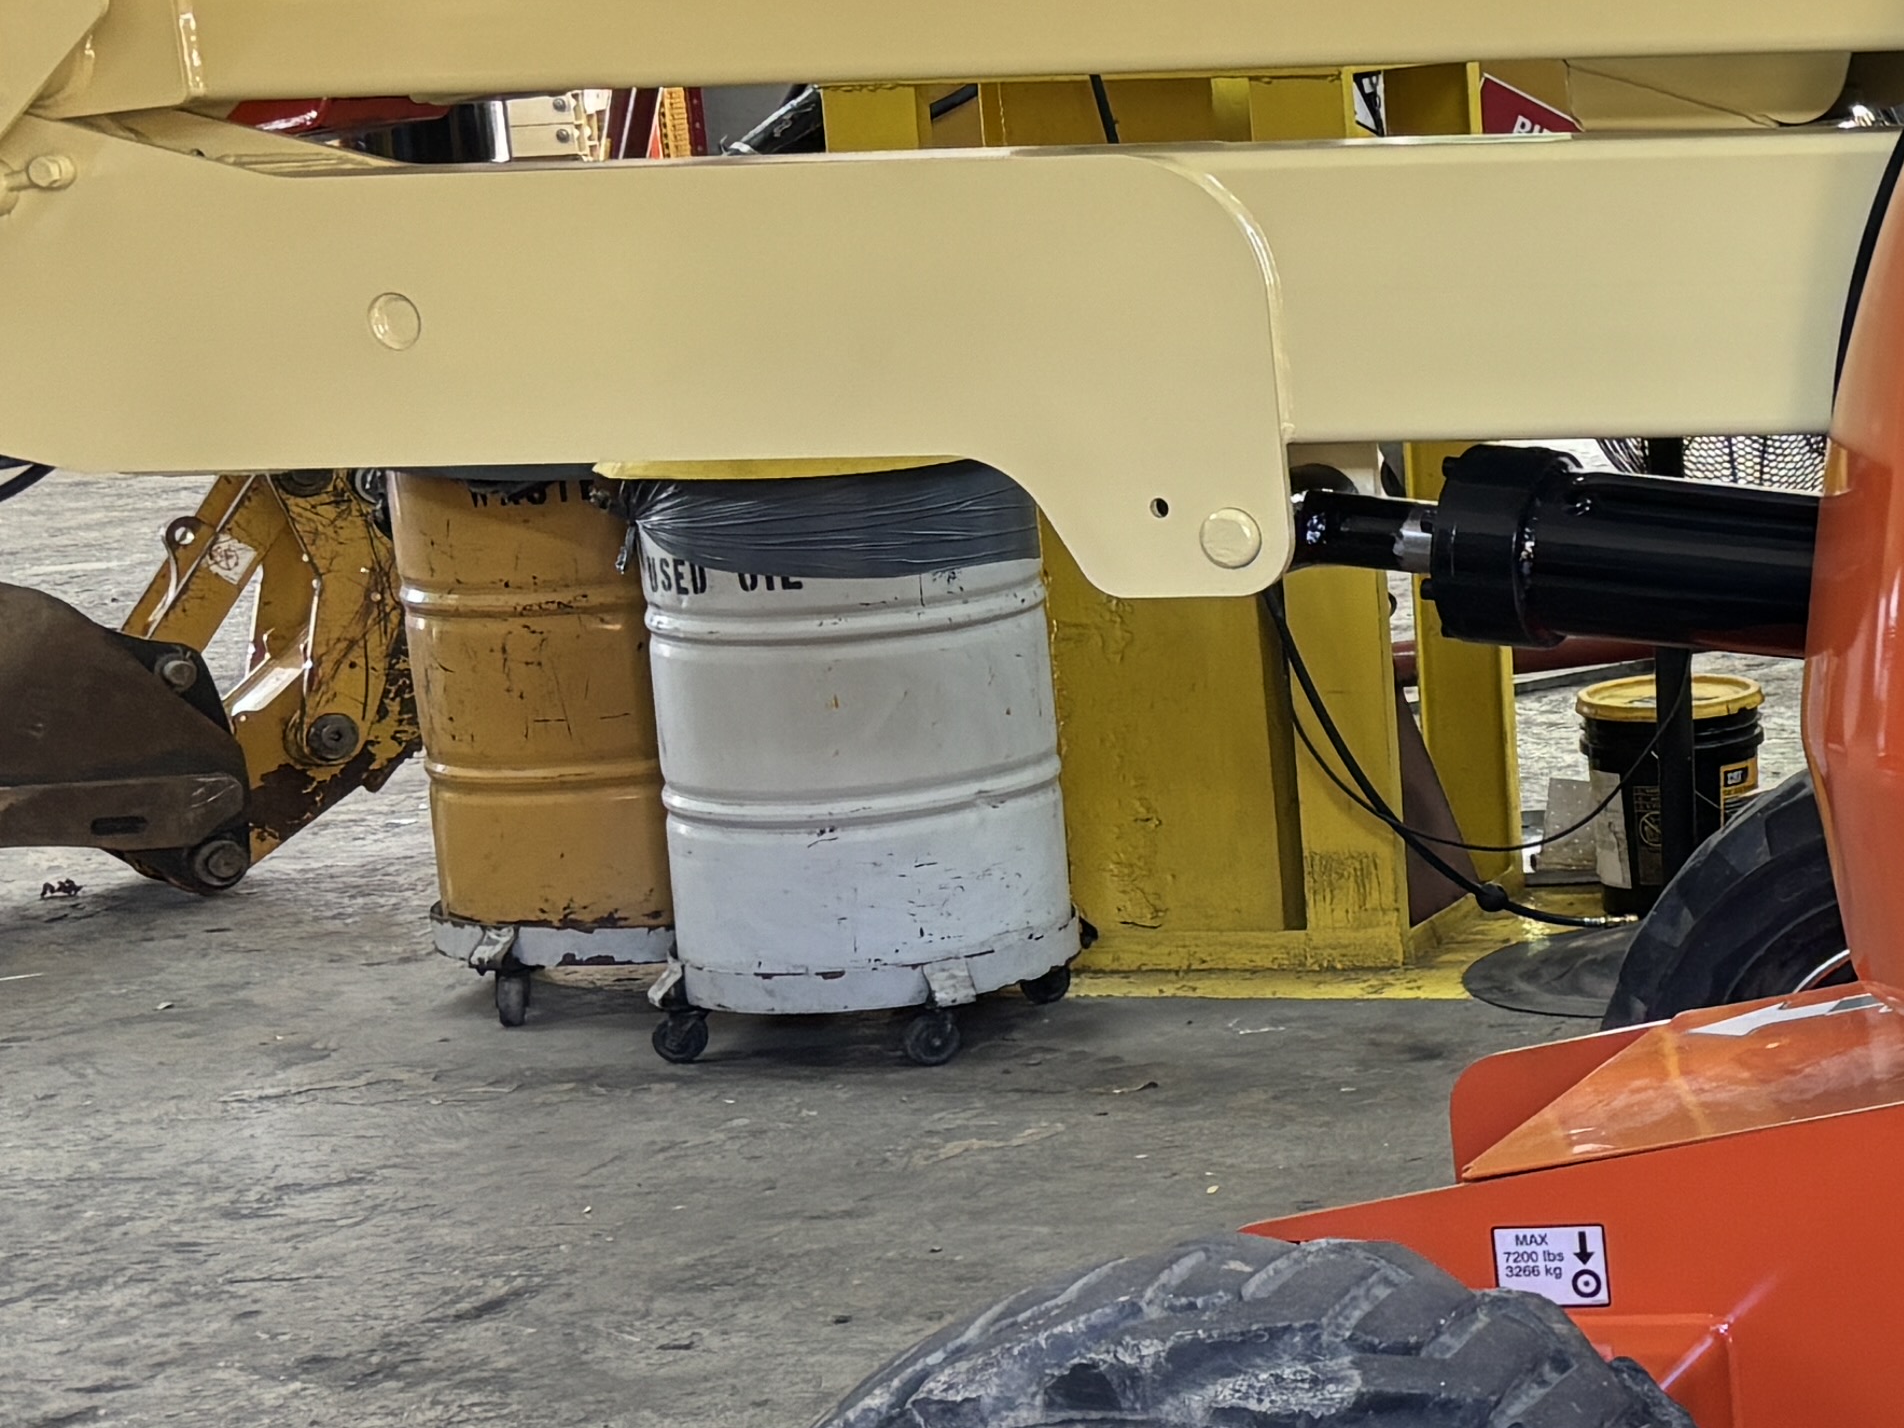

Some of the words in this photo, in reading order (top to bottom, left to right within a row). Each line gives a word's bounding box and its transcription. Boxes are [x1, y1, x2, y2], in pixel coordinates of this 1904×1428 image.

[647, 556, 707, 595] USED
[1514, 1233, 1549, 1247] MAX
[1503, 1251, 1539, 1264] 7200
[1542, 1250, 1565, 1263] lbs
[1505, 1265, 1541, 1278] 3266
[1544, 1264, 1563, 1280] kg
